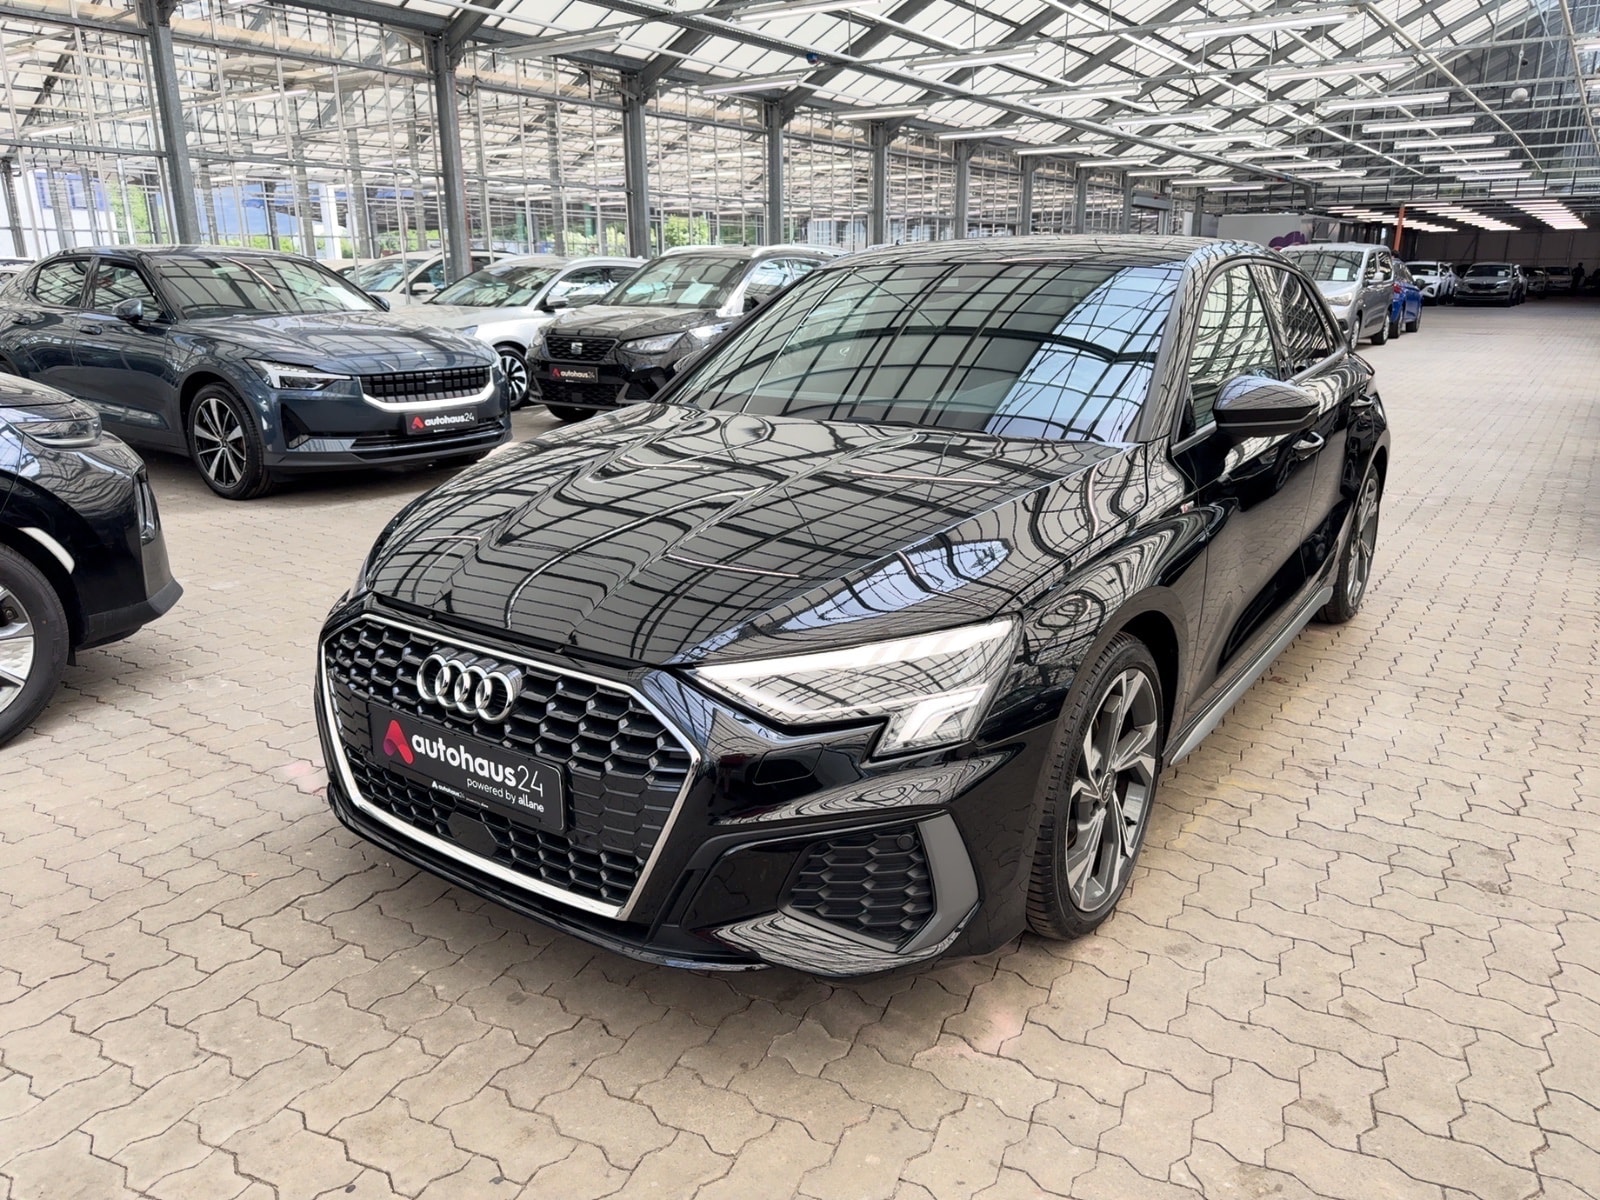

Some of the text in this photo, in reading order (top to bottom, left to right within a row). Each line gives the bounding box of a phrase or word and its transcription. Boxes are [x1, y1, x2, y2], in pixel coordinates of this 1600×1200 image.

[424, 412, 475, 427] autohaus24
[411, 733, 543, 797] autohaus24
[467, 777, 503, 798] powered
[505, 789, 516, 805] by
[518, 795, 545, 813] allane
